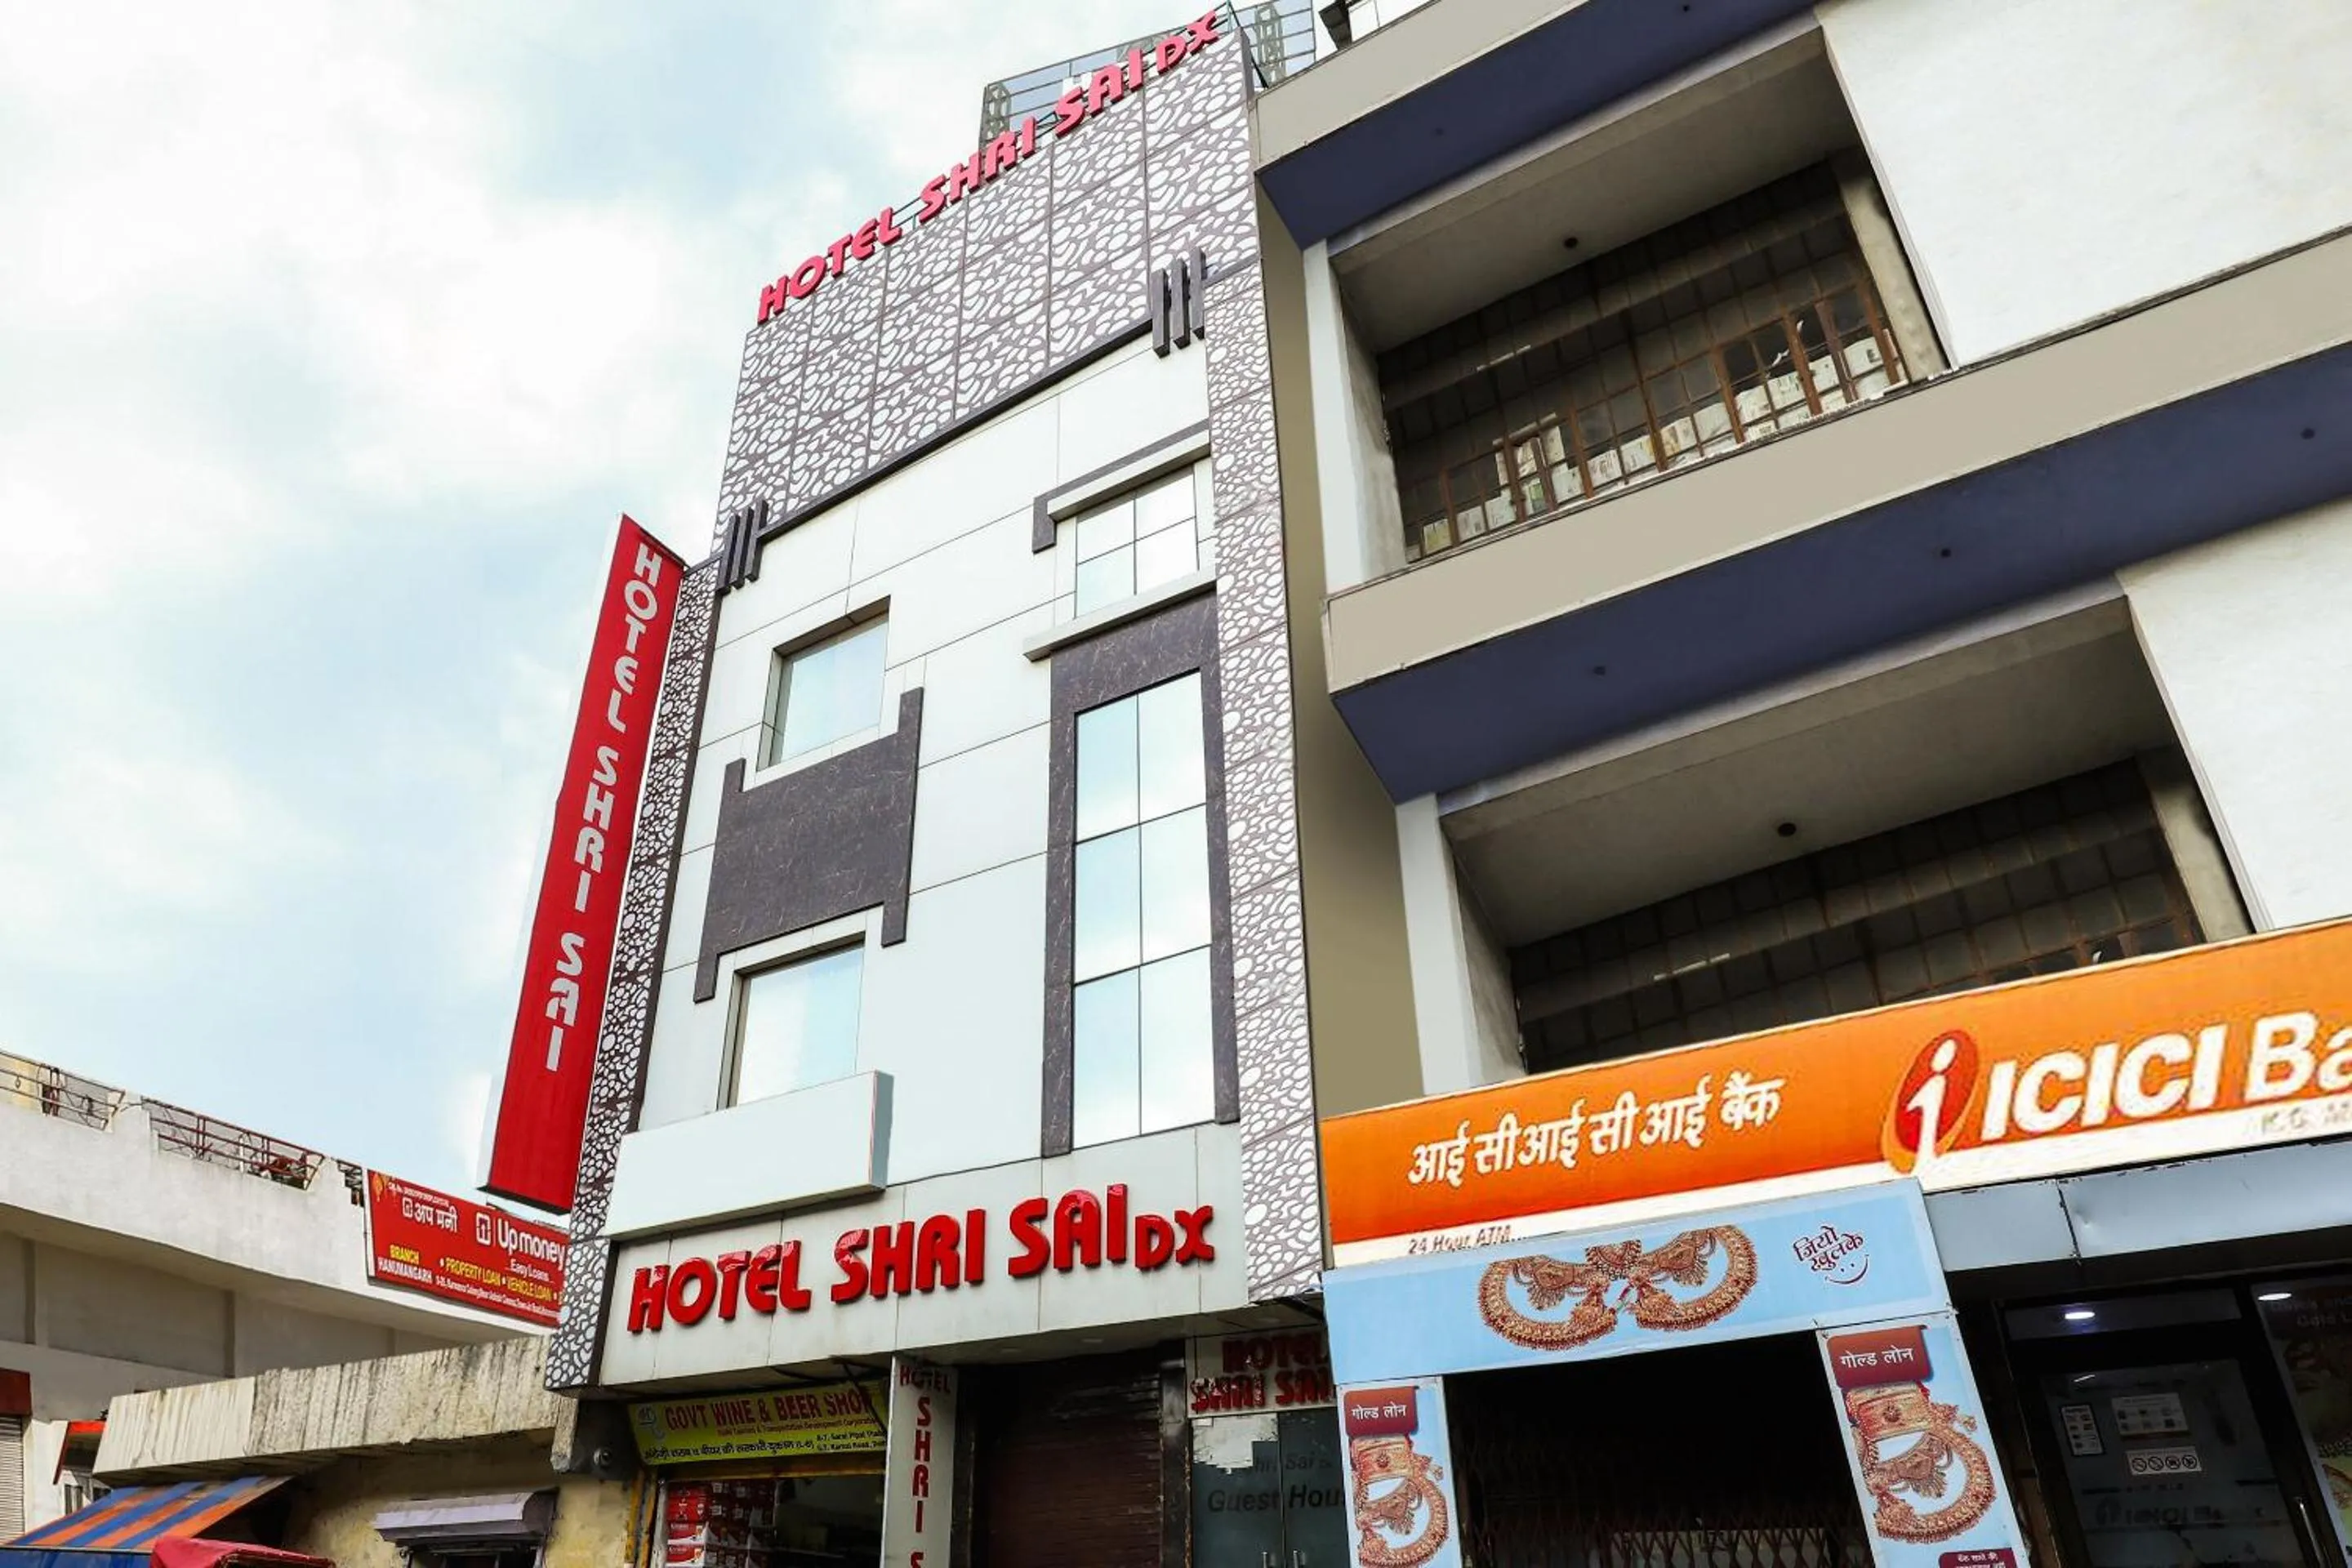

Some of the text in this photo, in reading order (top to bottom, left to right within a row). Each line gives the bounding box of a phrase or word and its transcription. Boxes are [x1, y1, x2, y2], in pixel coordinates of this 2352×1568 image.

[756, 207, 902, 326] HOTEL
[917, 115, 1039, 225] SHRI
[1053, 46, 1147, 139] SAI
[544, 541, 664, 1072] HOTEL SHRI SAI
[1718, 1069, 1786, 1132] बैंक
[1980, 1024, 2229, 1143] ICICI
[435, 1205, 458, 1233] मनी
[497, 1217, 567, 1272] Upmoney
[1409, 1239, 1428, 1254] 24
[1476, 1225, 1511, 1245] ATM
[626, 1238, 812, 1334] HOTEL
[830, 1208, 987, 1304] SHRI
[1008, 1183, 1129, 1279] SAI
[1134, 1205, 1215, 1271] DX
[1839, 1344, 1914, 1368] गोल्ड लोन
[665, 1405, 710, 1431] GOVT
[712, 1399, 757, 1427] WINE
[759, 1398, 772, 1423] &
[774, 1392, 822, 1421] BEER
[1351, 1401, 1407, 1420] गोल्ड लोन
[912, 1396, 932, 1534] SHRI
[1207, 1489, 1280, 1512] Guest
